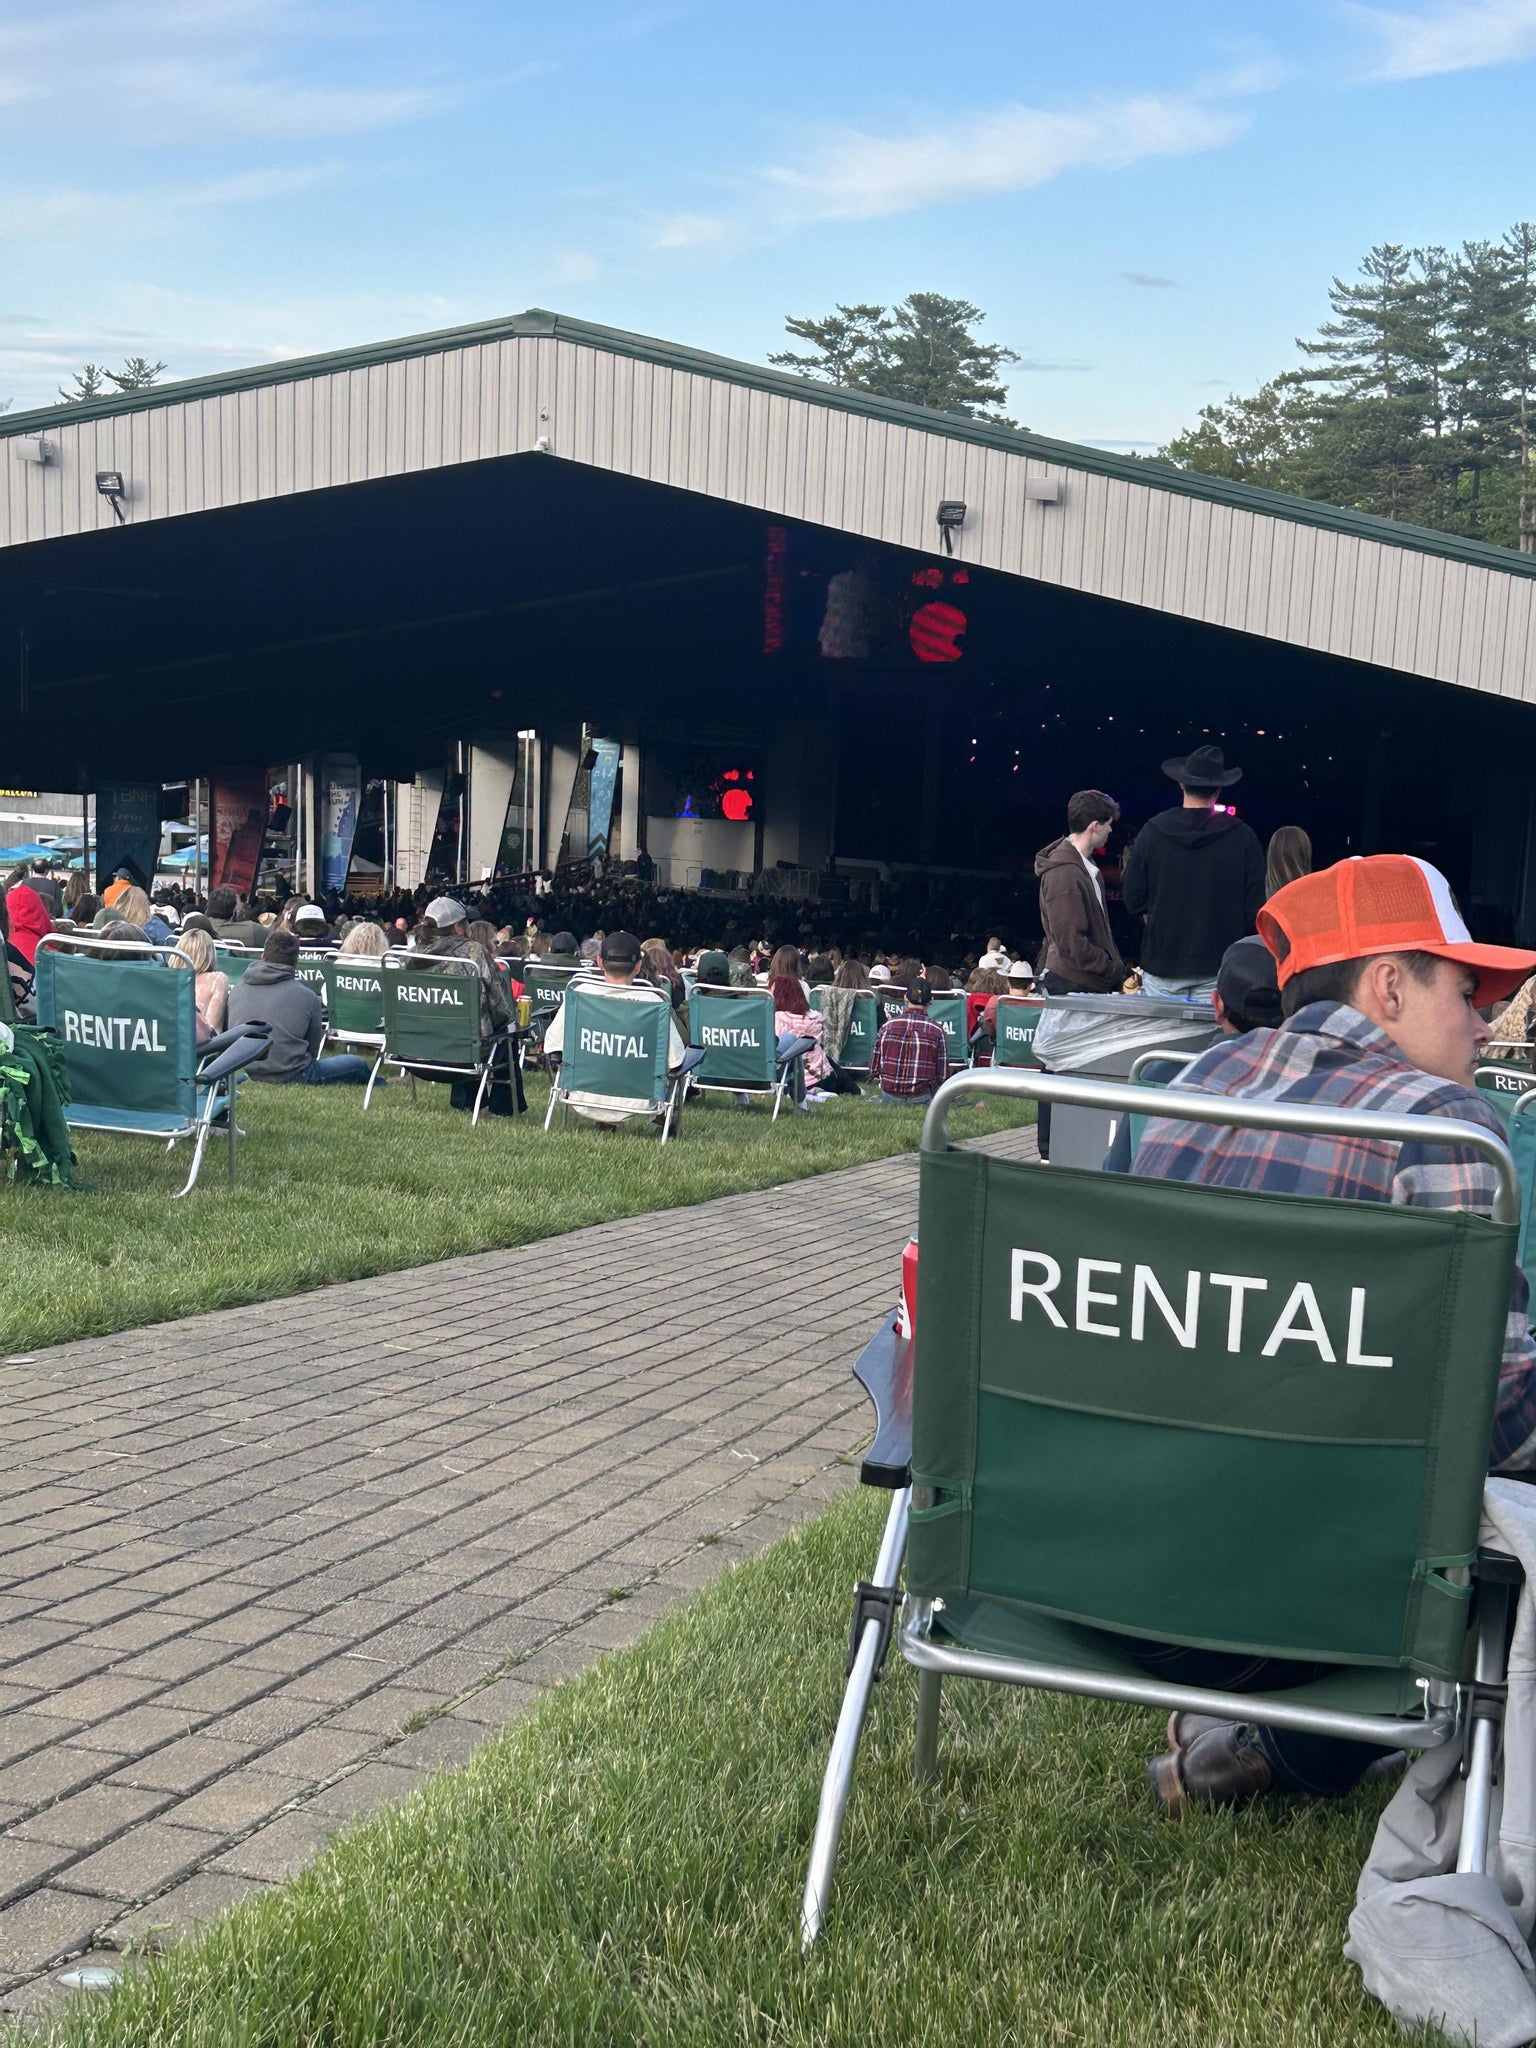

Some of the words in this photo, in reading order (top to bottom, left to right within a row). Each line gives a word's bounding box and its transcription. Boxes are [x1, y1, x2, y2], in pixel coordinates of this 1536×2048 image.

[294, 969, 325, 981] ENTA
[336, 976, 382, 992] RENTA
[397, 986, 463, 1005] RENTAL
[536, 988, 566, 1002] RENT
[884, 1002, 905, 1014] REN
[64, 1009, 166, 1052] RENTAL
[702, 1026, 760, 1048] RENTAL
[1006, 1026, 1035, 1042] RENT
[580, 1028, 649, 1058] RENTAL
[1495, 1074, 1529, 1091] REN
[1010, 1247, 1394, 1368] RENTAL
